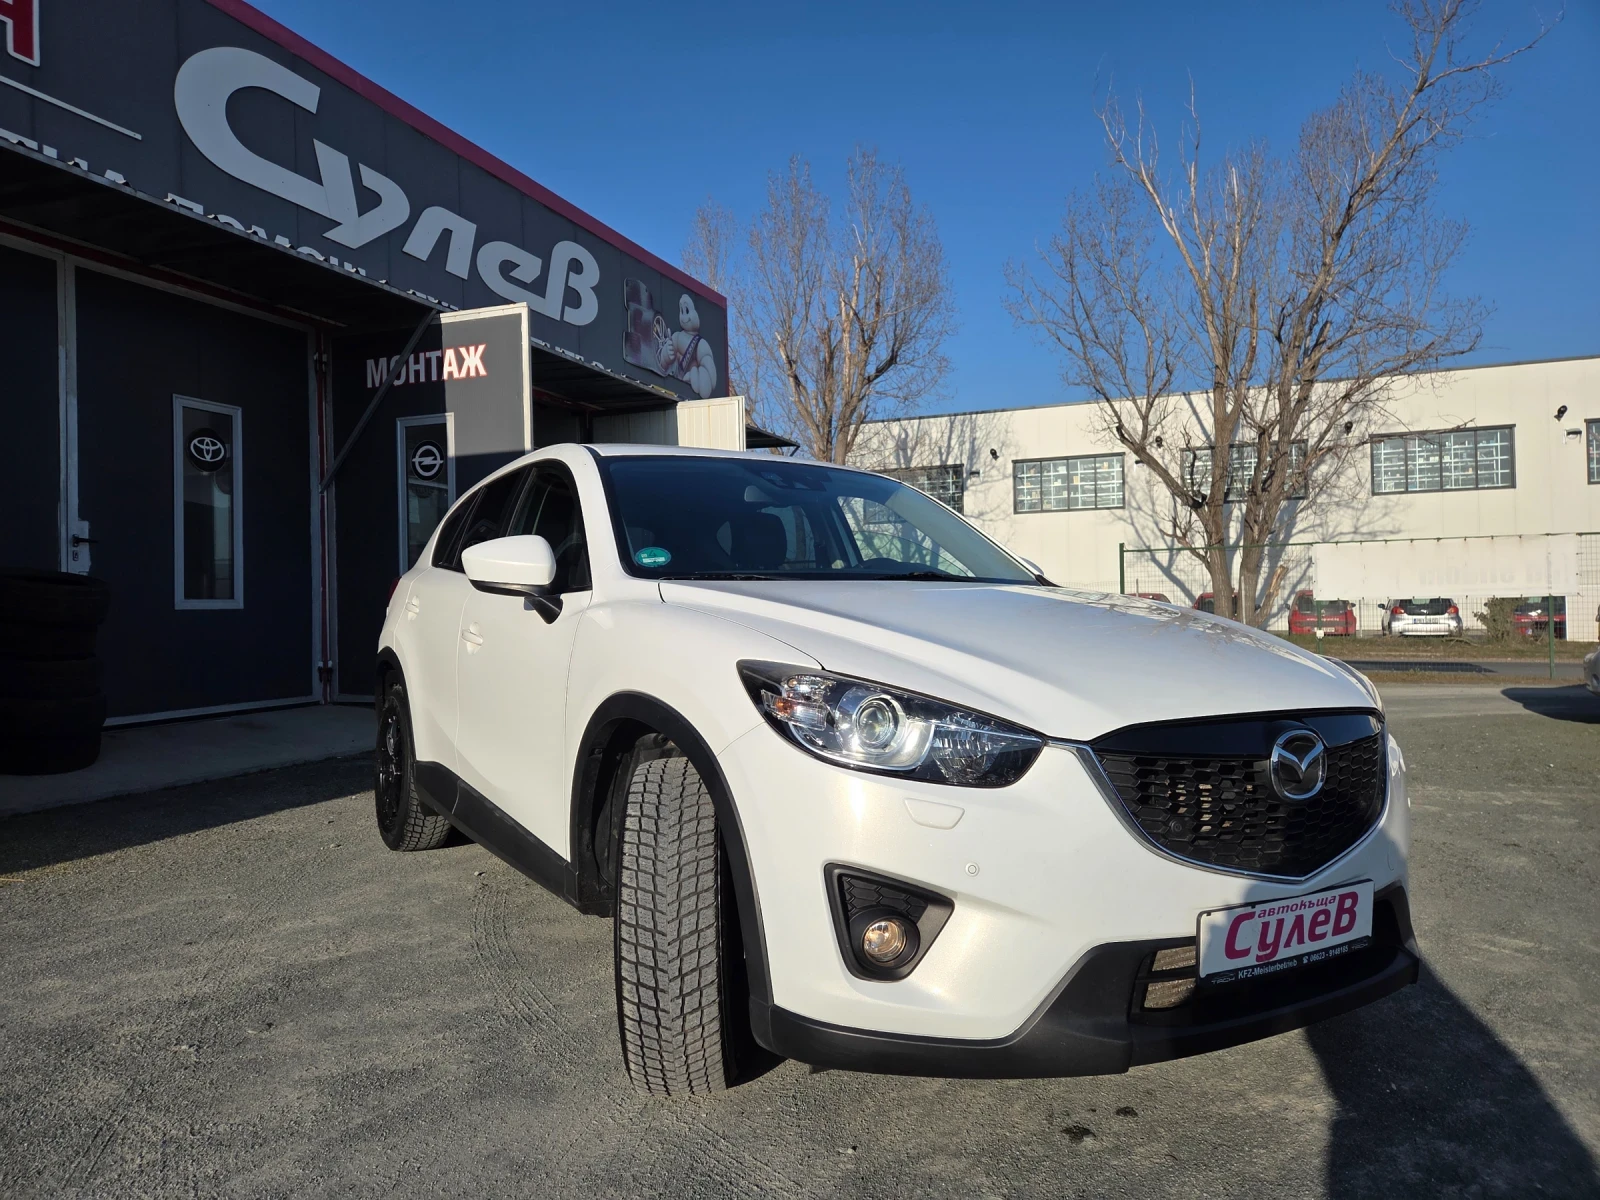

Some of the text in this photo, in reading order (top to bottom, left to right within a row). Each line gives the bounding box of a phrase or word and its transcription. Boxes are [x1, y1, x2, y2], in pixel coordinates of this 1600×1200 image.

[366, 344, 487, 388] МОНТАЖ
[1258, 895, 1336, 918] автокъща
[1238, 959, 1298, 979] KFZ-Meisterbetrieb
